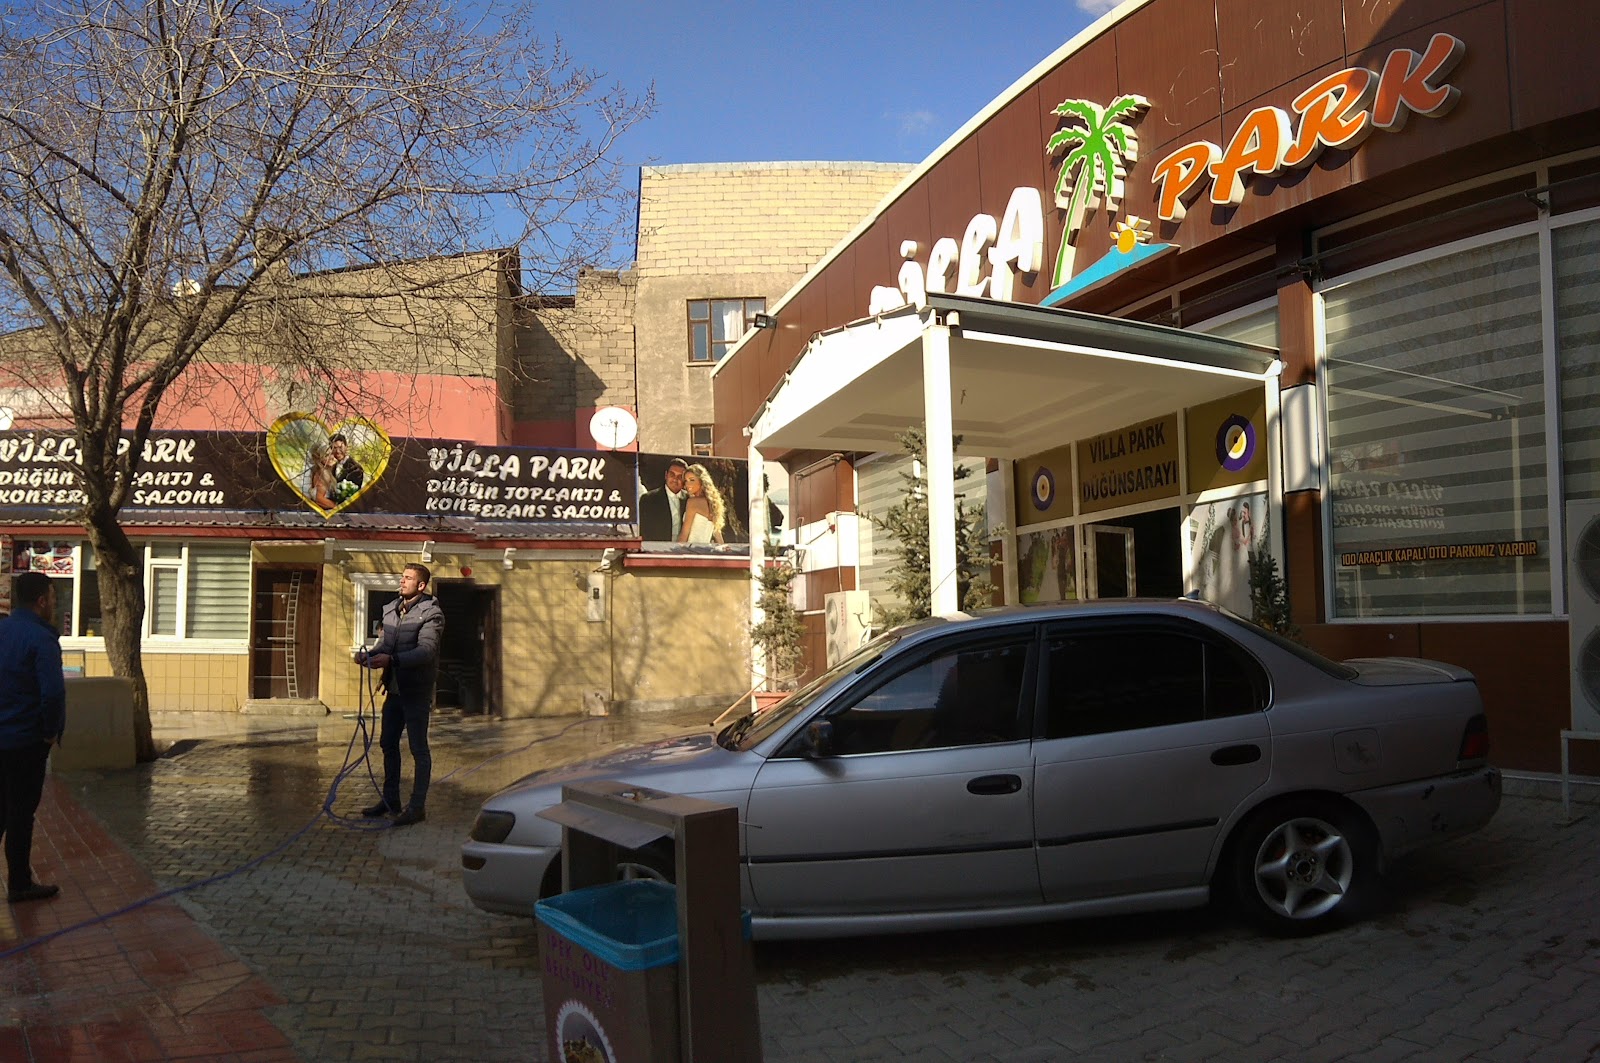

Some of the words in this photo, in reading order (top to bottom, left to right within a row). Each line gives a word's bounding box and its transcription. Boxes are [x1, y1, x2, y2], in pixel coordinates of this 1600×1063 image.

[1151, 32, 1465, 222] PARK
[0, 432, 84, 466] VİLL
[1128, 422, 1165, 454] PARK
[427, 442, 521, 482] VİLLA
[529, 455, 606, 483] PARK
[199, 473, 215, 487] &
[132, 490, 225, 506] SALONU
[608, 489, 621, 502] &
[552, 504, 630, 520] SALONU
[1341, 553, 1357, 566] 100
[1358, 551, 1394, 567] ARAÇLIK
[1395, 547, 1427, 563] KAPALI
[1429, 545, 1448, 559] OTO
[1449, 543, 1496, 558] PARKIMIZ
[1497, 541, 1538, 557] VARDIR
